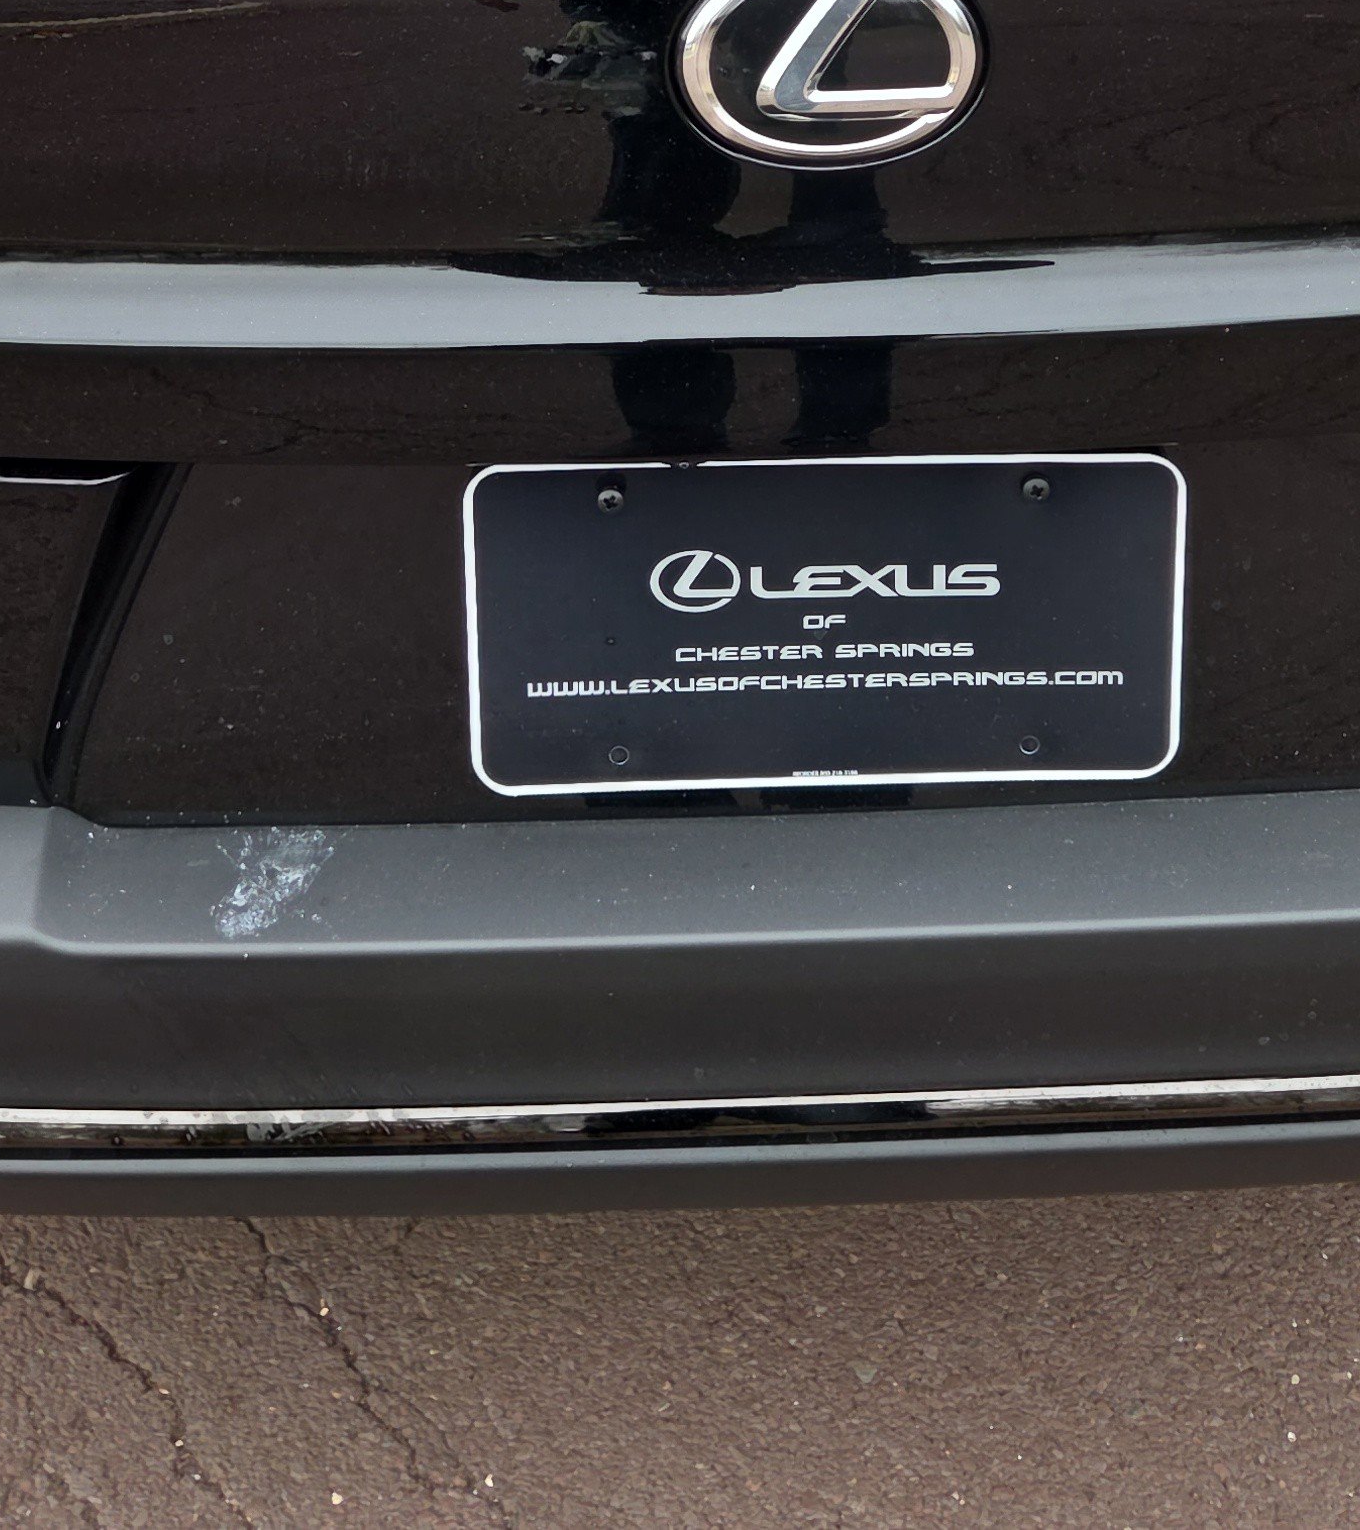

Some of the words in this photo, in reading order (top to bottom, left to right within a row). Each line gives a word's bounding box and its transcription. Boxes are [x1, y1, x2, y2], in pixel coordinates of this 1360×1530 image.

[750, 563, 1001, 599] LEXUS
[802, 614, 847, 630] OF
[675, 644, 823, 662] CHESTER
[835, 642, 975, 659] SPRINGS
[526, 670, 1124, 698] WWW.LEXUSOFCHESTERSPRINGS.COM
